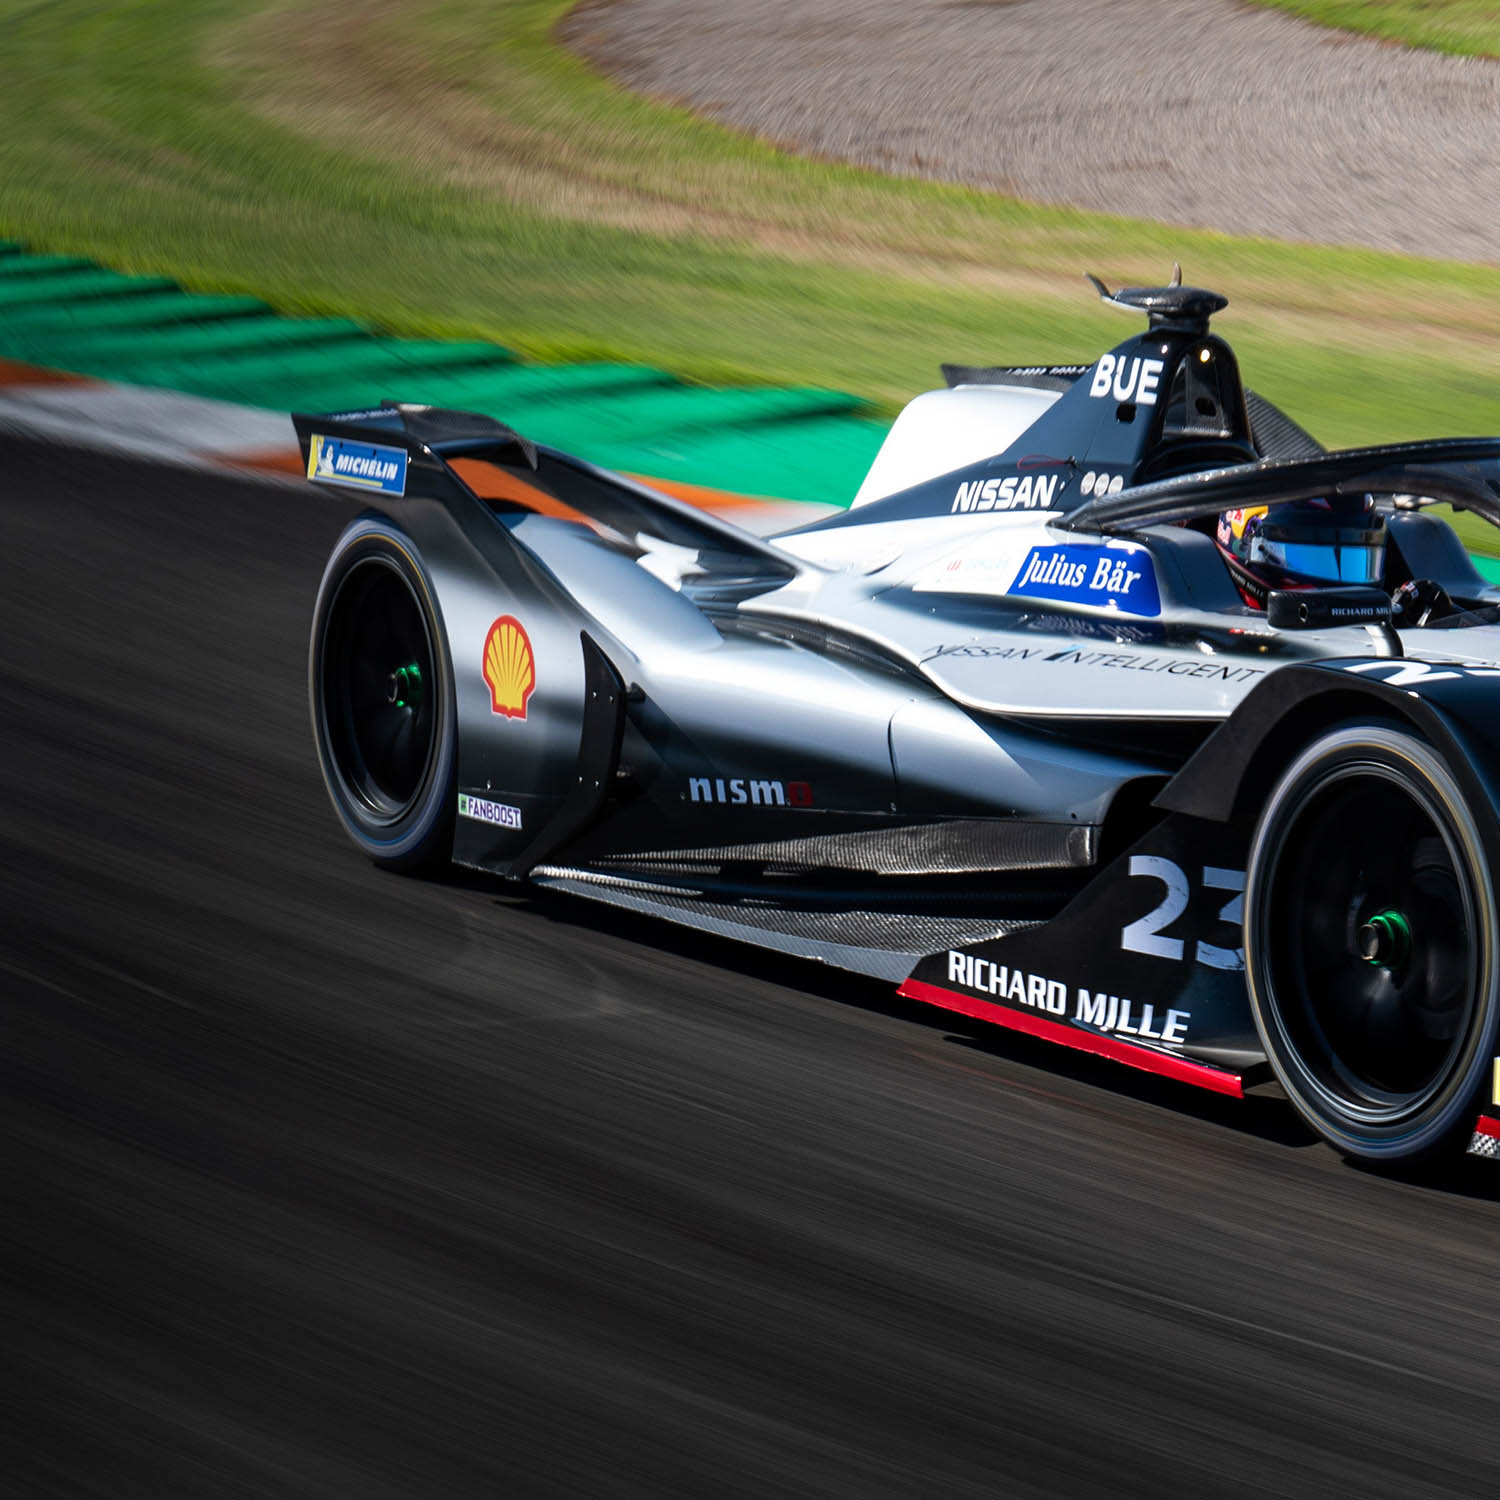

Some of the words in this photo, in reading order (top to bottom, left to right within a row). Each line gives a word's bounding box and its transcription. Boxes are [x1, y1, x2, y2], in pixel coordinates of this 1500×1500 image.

[1090, 354, 1164, 405] BUE
[336, 454, 398, 480] MICHELIN
[951, 475, 1058, 513] NISSAN
[1018, 551, 1088, 589] Julius
[1089, 557, 1141, 594] Bär
[1331, 607, 1374, 616] RICHARD
[1042, 644, 1266, 683] INTELLIGENT
[688, 776, 813, 806] nismo
[460, 797, 520, 828] #FANBOOST
[948, 950, 1067, 1016] RICHARD
[1075, 989, 1191, 1044] MILLE
